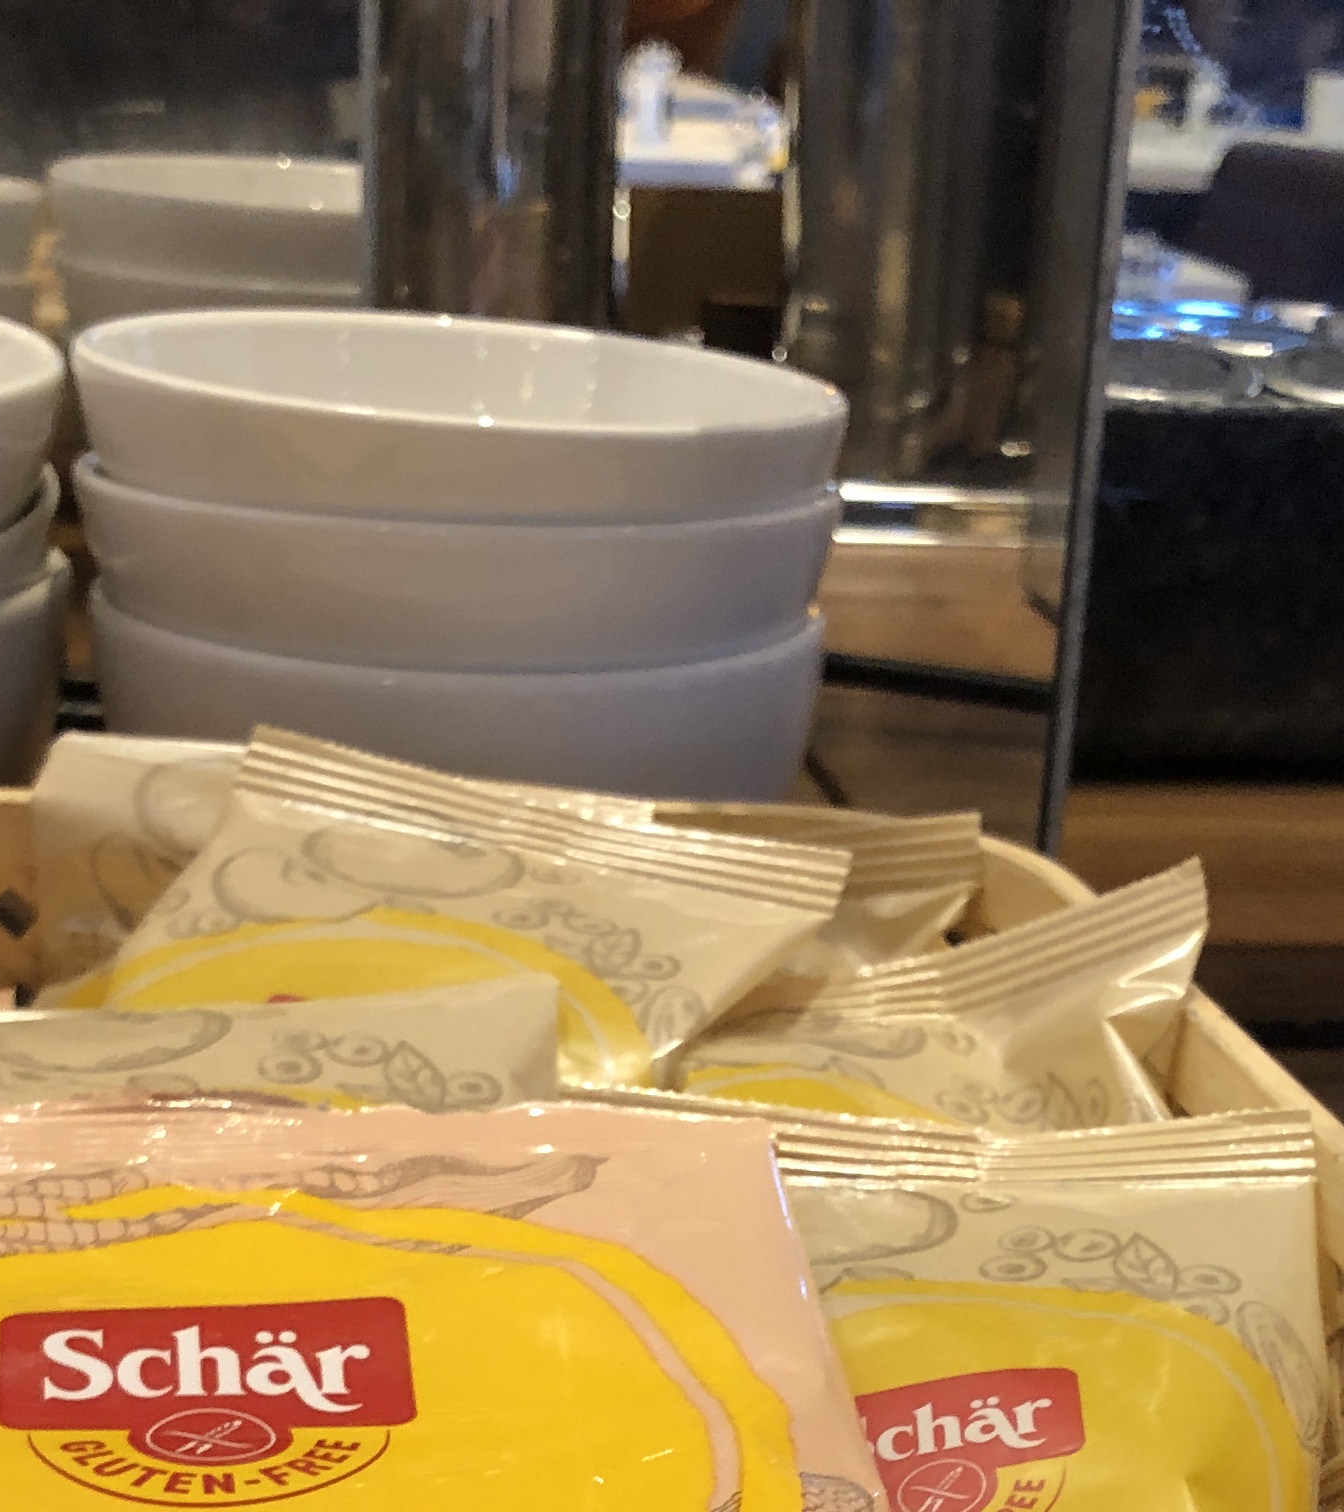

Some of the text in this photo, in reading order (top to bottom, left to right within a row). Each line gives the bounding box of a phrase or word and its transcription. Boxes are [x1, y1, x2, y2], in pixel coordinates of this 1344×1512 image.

[42, 1325, 370, 1413] Schär
[861, 1396, 1053, 1462] chär
[60, 1438, 361, 1495] GLUTEN-FREE
